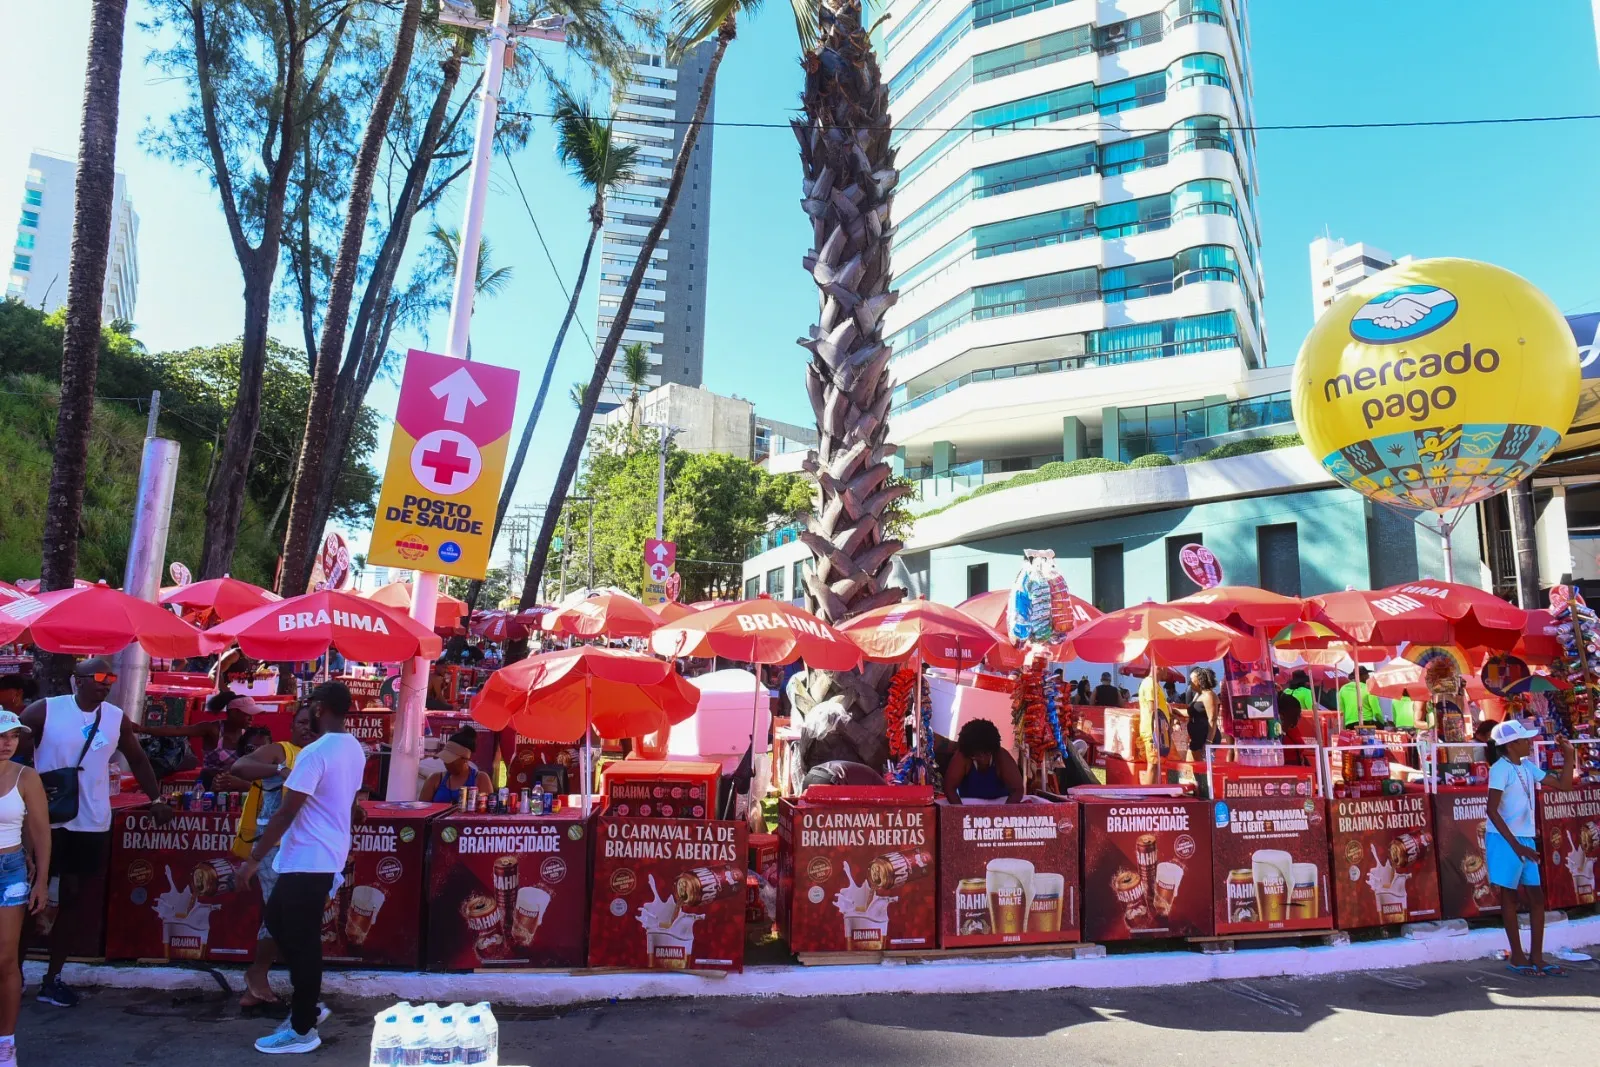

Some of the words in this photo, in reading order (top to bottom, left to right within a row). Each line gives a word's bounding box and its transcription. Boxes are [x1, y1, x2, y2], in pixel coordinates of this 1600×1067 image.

[1324, 343, 1500, 402] mercado
[1362, 385, 1457, 429] pago
[403, 495, 472, 518] POSTO
[386, 506, 413, 525] DE
[279, 609, 390, 635] BRAHMA
[736, 612, 836, 643] BRAHMA
[945, 648, 972, 659] BRAMA
[371, 719, 384, 727] DE
[612, 785, 650, 799] BRAHMA
[1227, 783, 1262, 797] BRAHMA
[1544, 793, 1549, 804] O
[1550, 789, 1581, 804] CARNAVAL
[1583, 787, 1592, 801] TÁ
[1339, 803, 1346, 815] O
[1348, 800, 1395, 814] CARNAVAL
[1397, 796, 1409, 812] TÁ
[1412, 798, 1424, 810] DE
[1461, 797, 1488, 805] CARNA
[1110, 807, 1117, 815] O
[1119, 806, 1171, 814] CARNAVAL
[1173, 806, 1186, 814] DA
[1230, 809, 1237, 821] É
[1239, 811, 1254, 821] NO
[1255, 809, 1308, 821] CARNAVAL
[1544, 804, 1576, 819] BRAHMAS
[1577, 802, 1600, 816] ABERTA
[126, 815, 136, 830] O
[214, 813, 231, 832] TÁ
[803, 814, 813, 829] O
[816, 813, 883, 829] CARNAVAL
[886, 810, 903, 828] TÁ
[906, 812, 924, 827] DE
[963, 815, 971, 828] É
[973, 817, 992, 829] NO
[994, 816, 1057, 828] CARNAVAL
[1107, 815, 1189, 832] BRAHMOSIDADE
[1338, 814, 1384, 832] BRAHMAS
[1386, 812, 1426, 828] ABERTAS
[378, 825, 395, 834] DA
[463, 827, 470, 835] O
[474, 827, 535, 835] CARNAVAL
[540, 826, 557, 834] DA
[608, 823, 618, 838] O
[621, 824, 692, 841] CARNAVAL
[696, 822, 714, 842] TÁ
[717, 827, 735, 842] DE
[801, 829, 865, 847] BRAHMAS
[868, 829, 925, 846] ABERTAS
[963, 828, 977, 840] QUE
[977, 828, 982, 840] A
[983, 828, 1003, 840] GENTE
[123, 832, 189, 849] BRAHMAS
[192, 834, 236, 851] ABERT
[459, 835, 560, 854] BRAHMOSIDADE
[605, 840, 672, 860] BRAHMAS
[675, 842, 737, 861] ABERTAS
[1264, 886, 1284, 895] MALTE
[998, 896, 1022, 906] MALTE
[171, 937, 199, 948] BRAHMA
[853, 930, 879, 941] BRAHMA
[655, 947, 683, 958] BRAHMA
